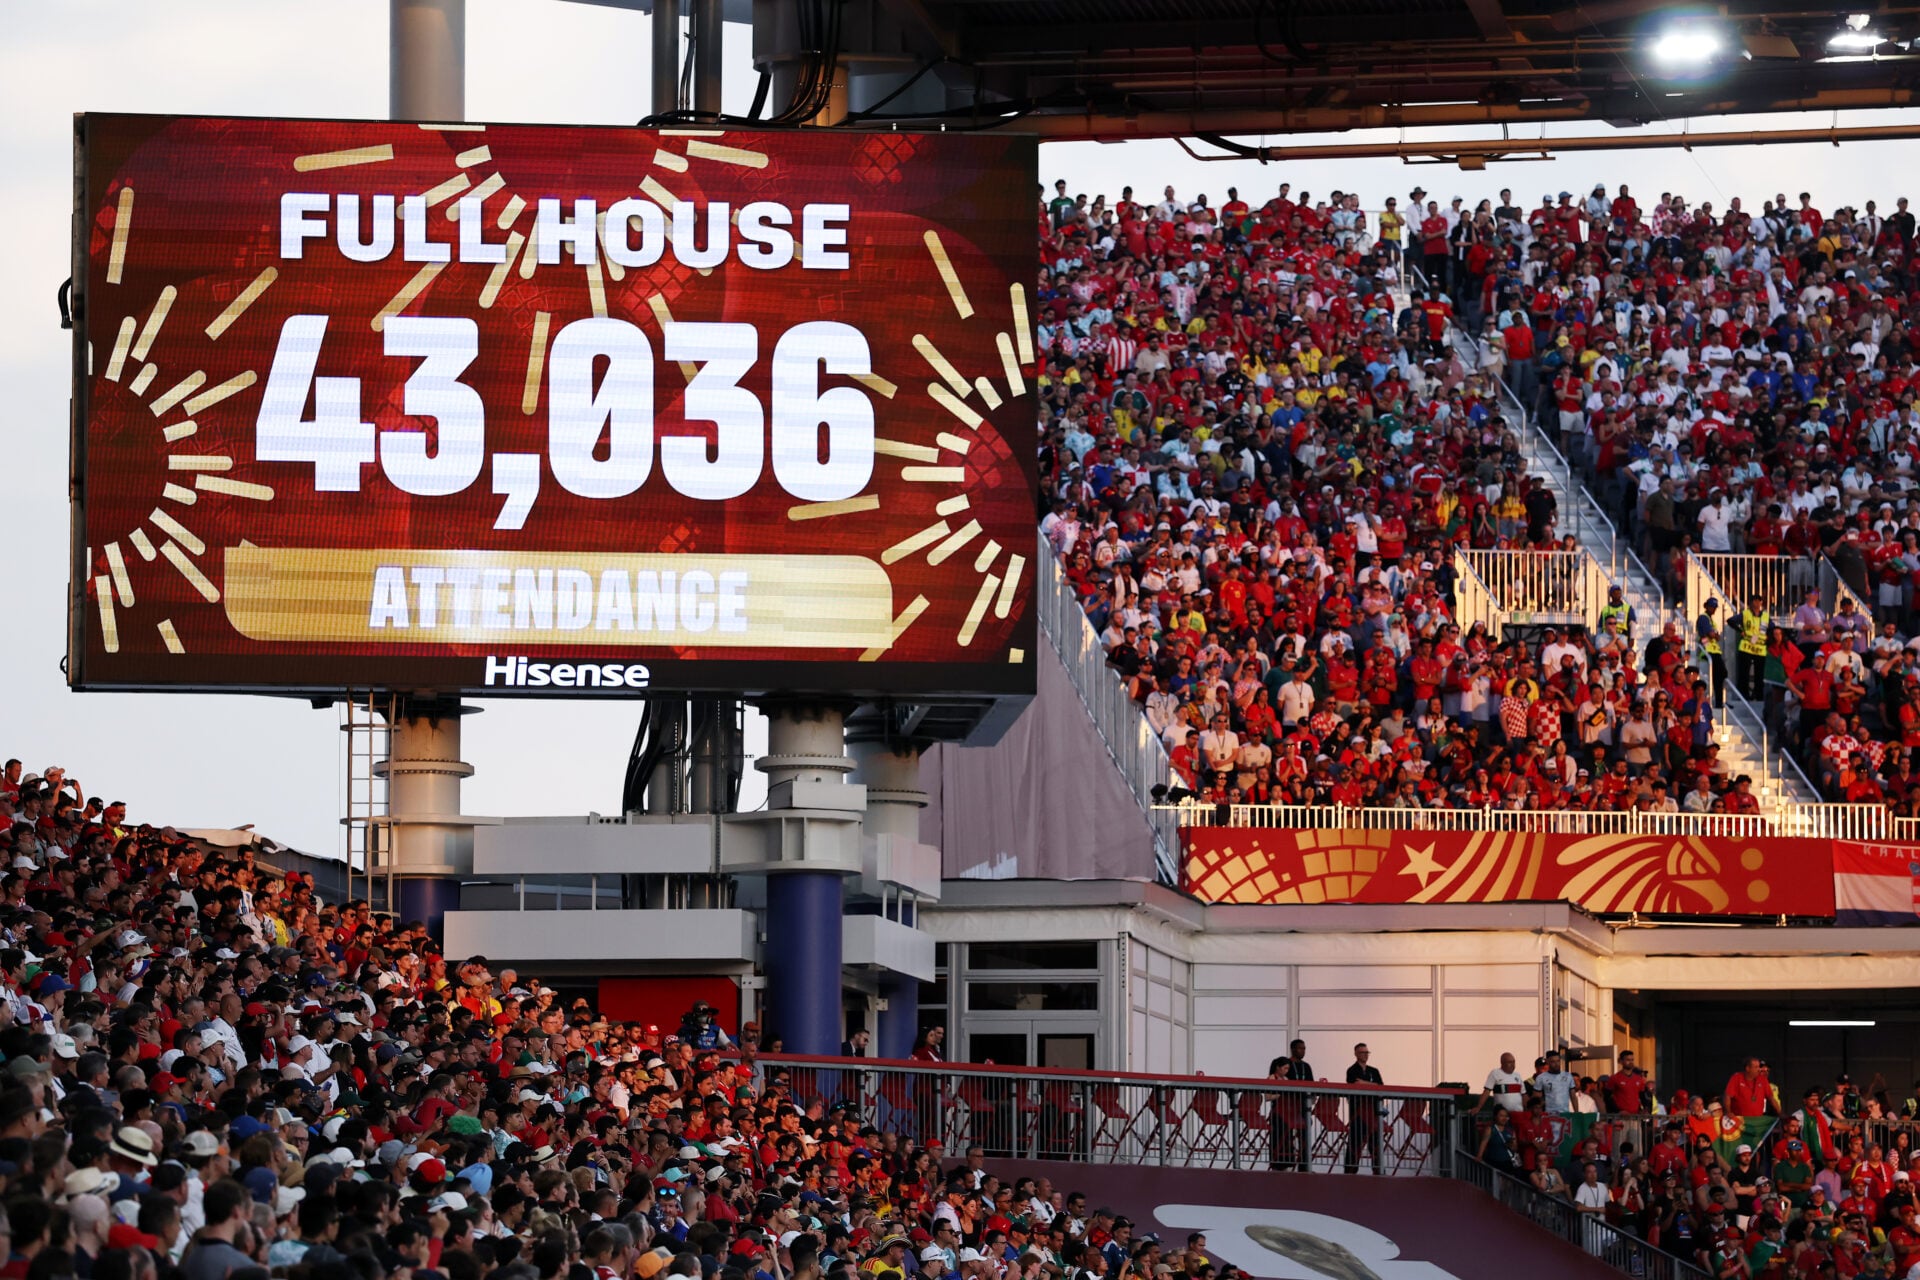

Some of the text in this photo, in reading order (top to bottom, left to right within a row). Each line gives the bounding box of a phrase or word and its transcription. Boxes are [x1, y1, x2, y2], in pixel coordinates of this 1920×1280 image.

[280, 192, 851, 271] FULL HOUSE
[255, 314, 876, 531] 43,036
[368, 565, 749, 633] ATTENDANCE
[484, 655, 651, 688] Hisense
